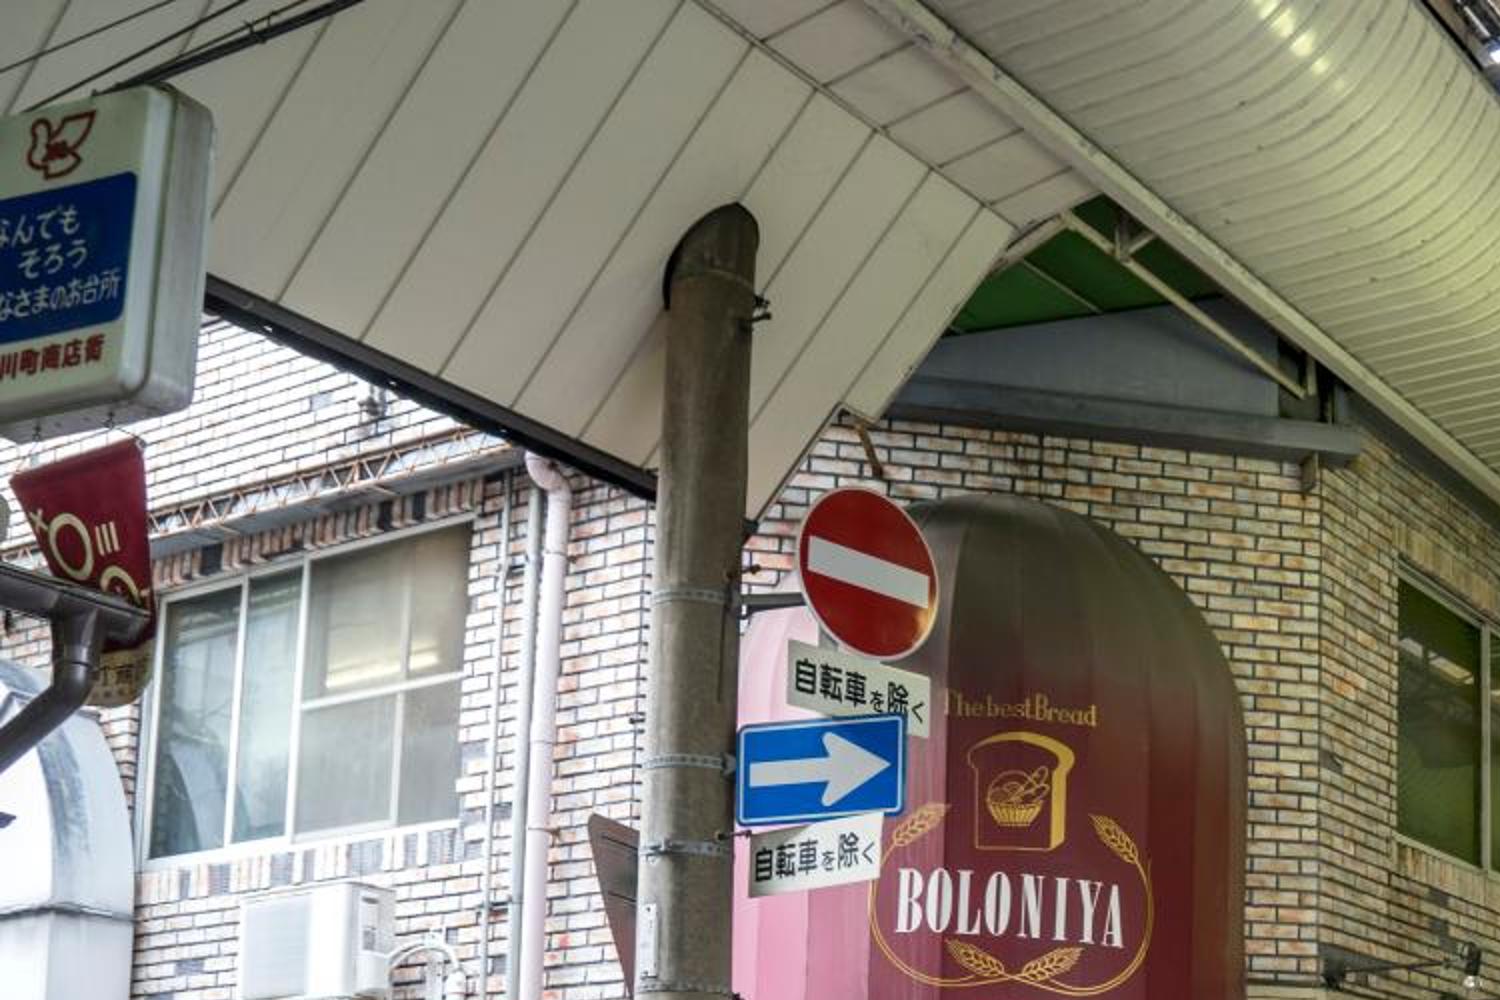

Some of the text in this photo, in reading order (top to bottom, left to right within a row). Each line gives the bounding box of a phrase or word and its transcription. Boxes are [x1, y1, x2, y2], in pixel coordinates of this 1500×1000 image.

[18, 239, 88, 279] そろう
[795, 657, 925, 723] 自転車を除く
[755, 832, 875, 883] 自転車を除く
[894, 866, 1124, 949] BOLONIYA
